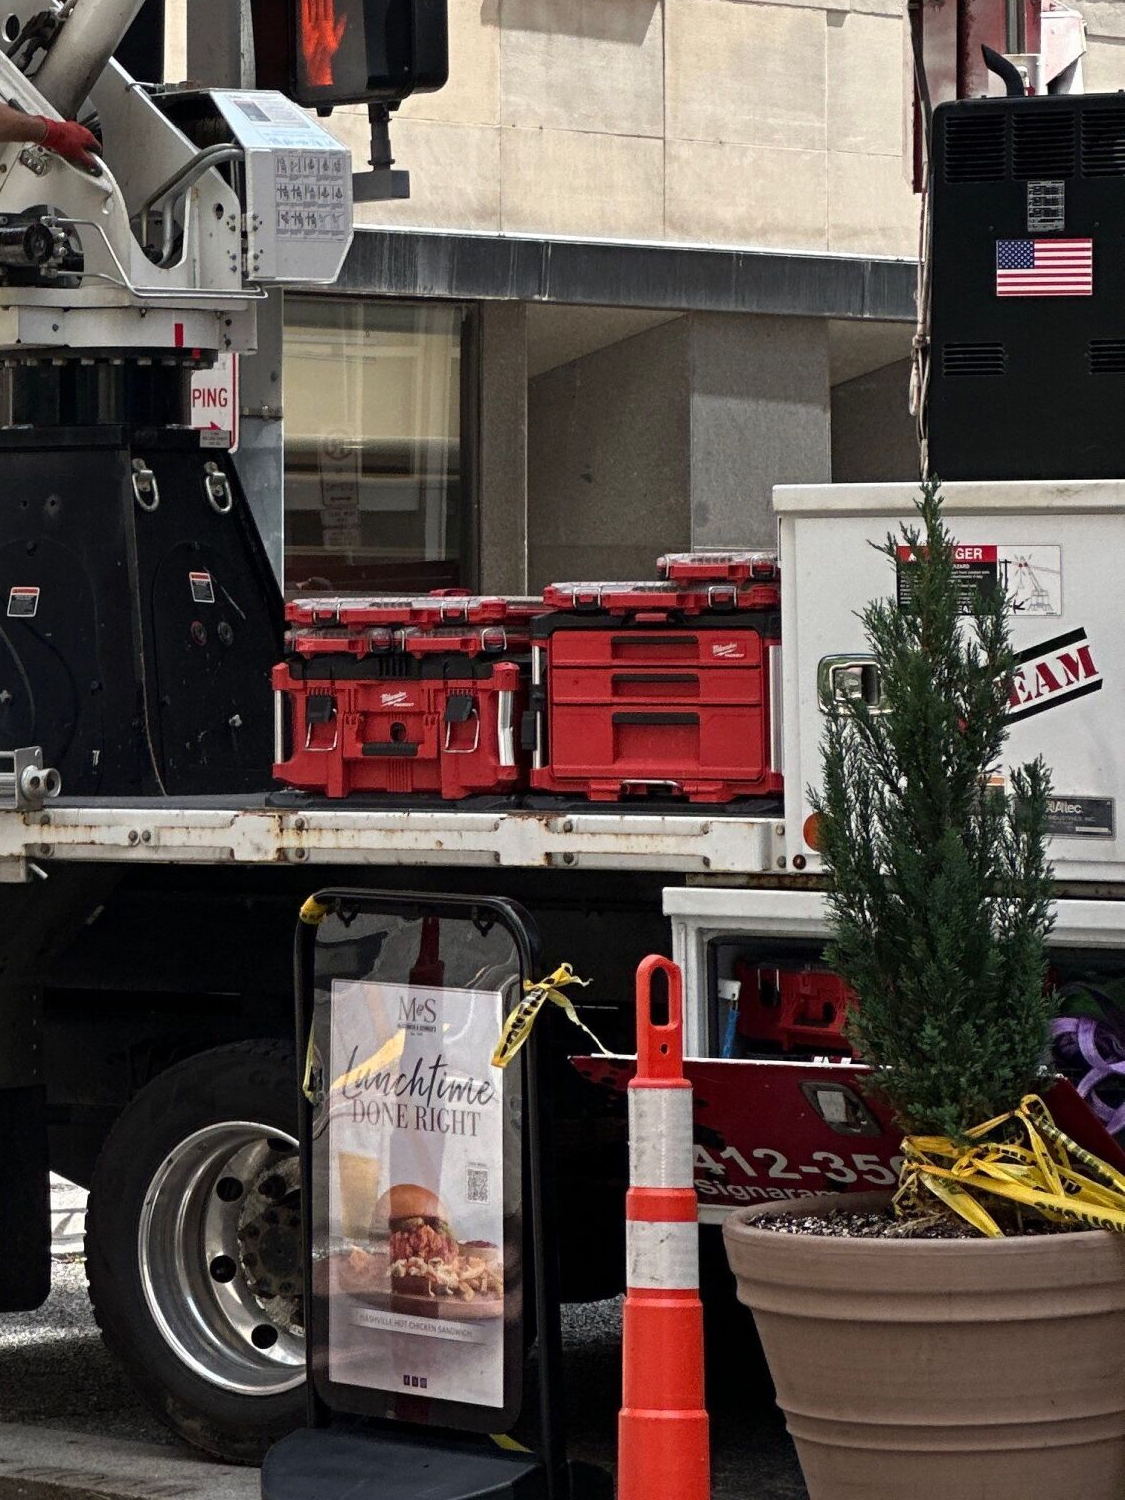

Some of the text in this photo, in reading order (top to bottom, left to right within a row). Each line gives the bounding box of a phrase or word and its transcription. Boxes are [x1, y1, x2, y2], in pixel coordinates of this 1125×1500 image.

[342, 1044, 496, 1108] Lunchtime
[352, 1100, 481, 1137] DONE RIGHT
